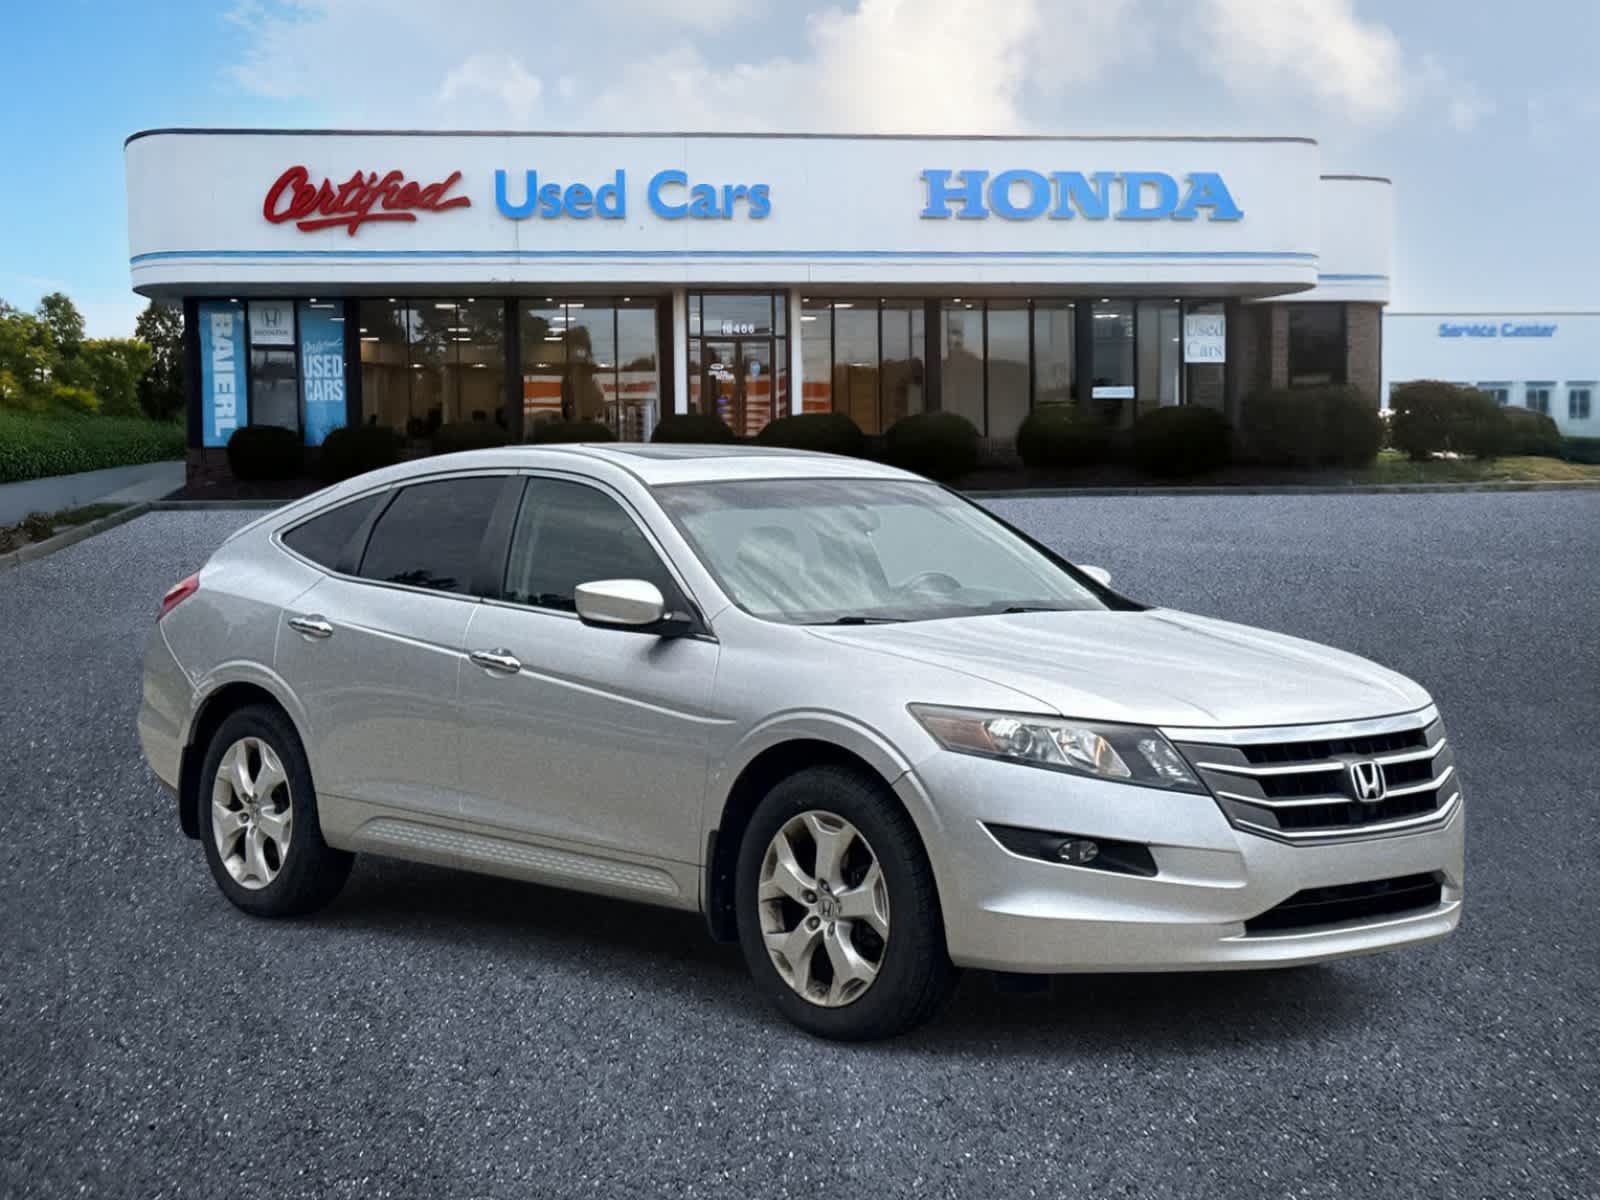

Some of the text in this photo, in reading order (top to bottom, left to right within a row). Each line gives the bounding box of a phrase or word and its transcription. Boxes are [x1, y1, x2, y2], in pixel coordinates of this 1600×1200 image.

[263, 165, 772, 236] Certified Used Cars
[919, 169, 1245, 222] HONDA
[1186, 318, 1225, 337] Used
[1438, 322, 1557, 338] Service Center
[1186, 341, 1224, 358] Cars
[303, 354, 343, 378] USED
[304, 379, 344, 402] CARS
